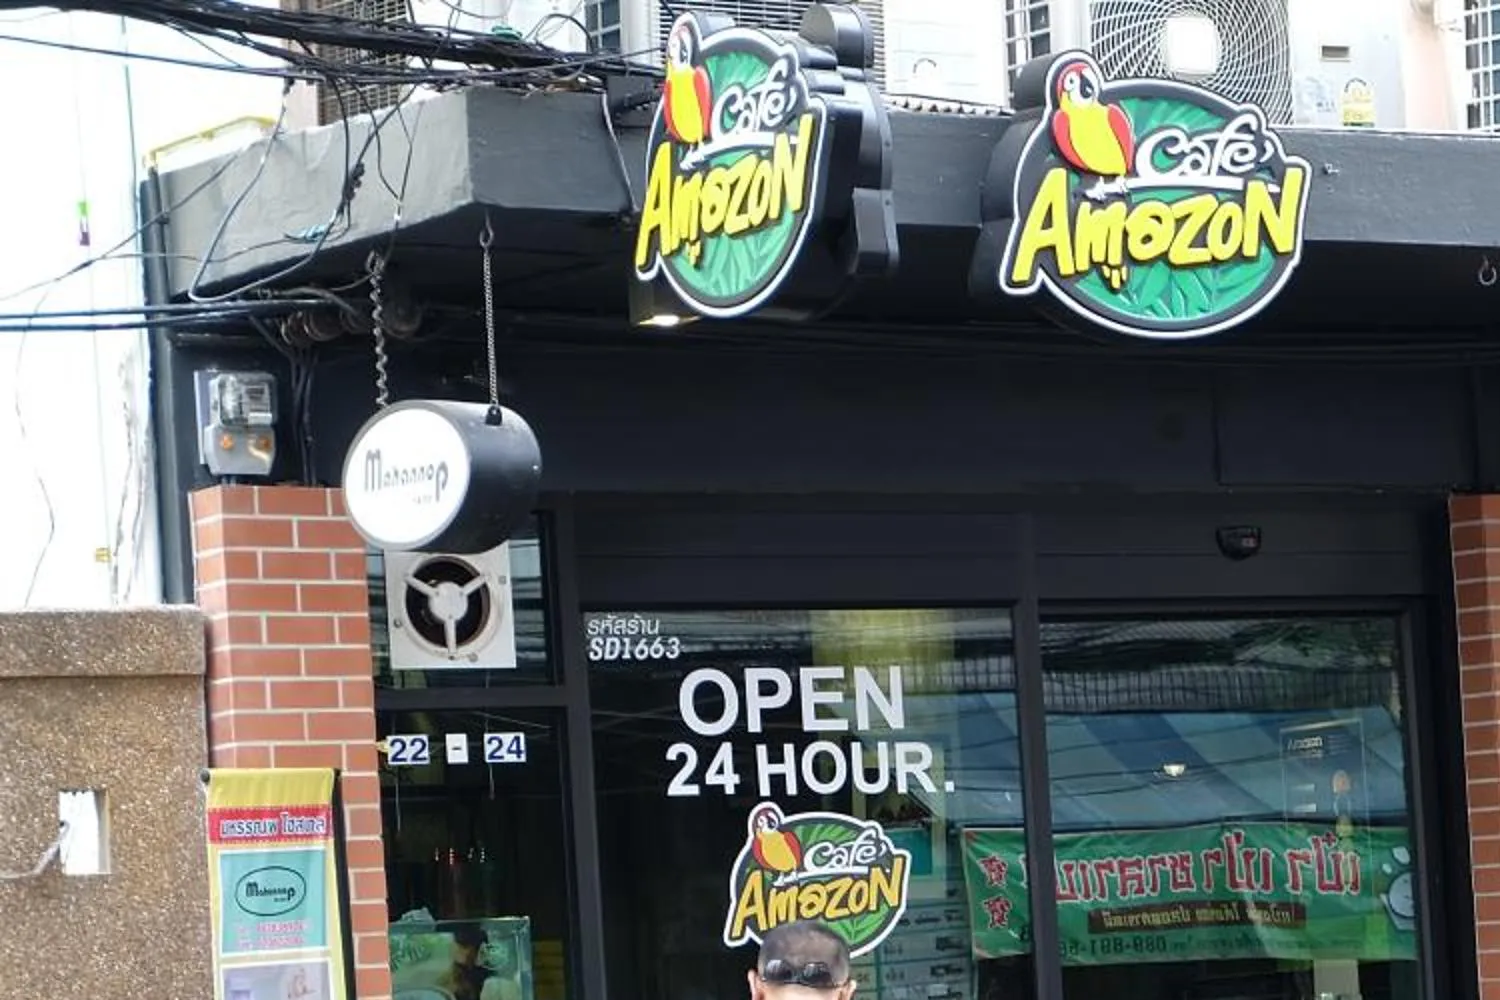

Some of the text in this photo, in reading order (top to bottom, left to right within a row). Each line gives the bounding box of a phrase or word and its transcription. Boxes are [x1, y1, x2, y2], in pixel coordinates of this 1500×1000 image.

[589, 636, 680, 661] SD1663
[679, 665, 905, 736] OPEN
[389, 736, 428, 763] 22
[486, 735, 525, 762] 24
[665, 740, 955, 797] 24 HOUR.
